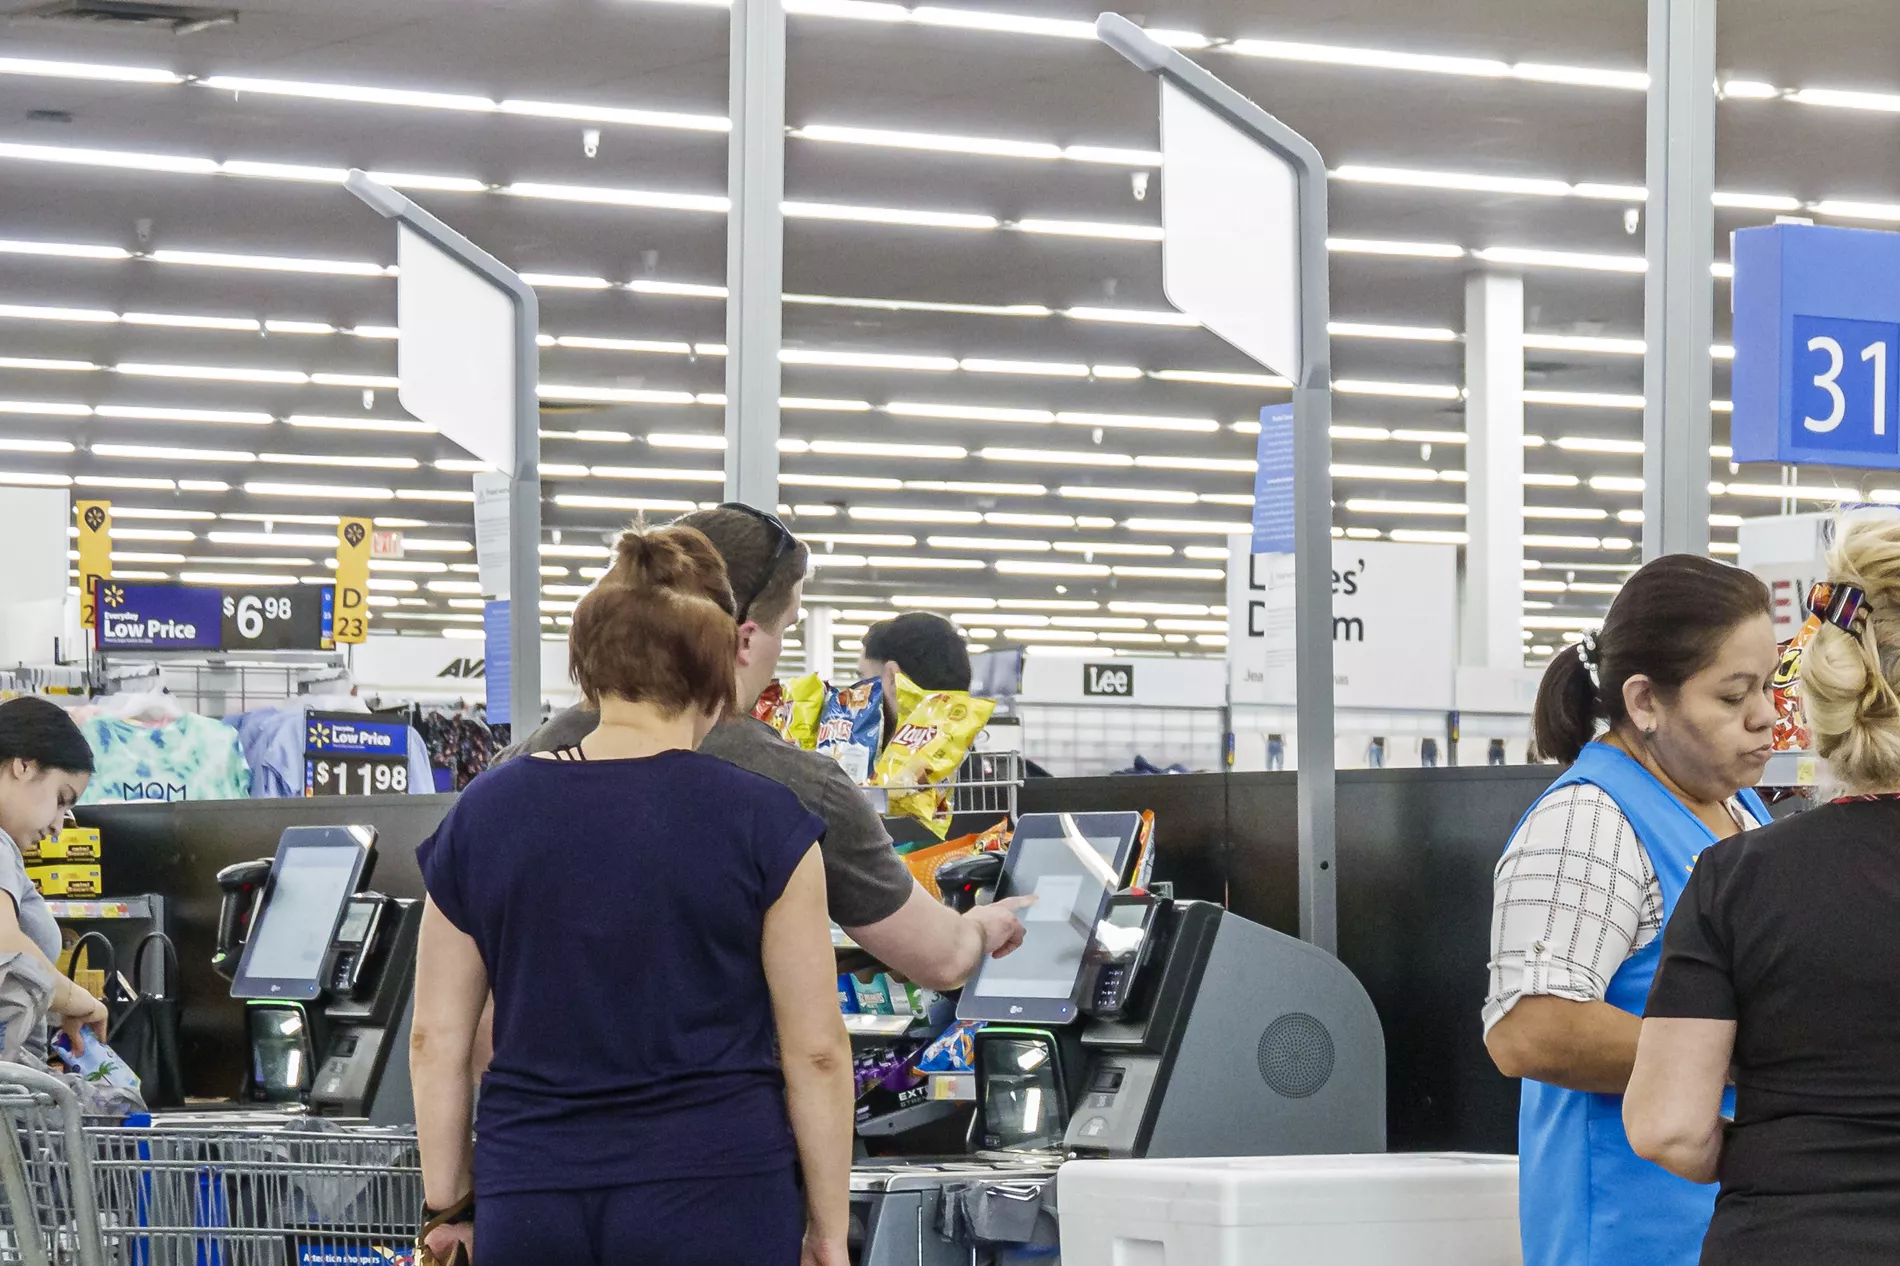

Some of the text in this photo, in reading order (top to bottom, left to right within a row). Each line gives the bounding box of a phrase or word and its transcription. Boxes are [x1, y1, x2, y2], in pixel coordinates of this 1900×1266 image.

[1803, 336, 1887, 436] 31
[343, 587, 361, 608] D
[104, 620, 196, 639] Low Price
[338, 616, 363, 638] 23
[1089, 667, 1128, 693] Lee
[332, 731, 359, 744] Low
[360, 731, 391, 747] Price
[892, 724, 938, 750] Lay's
[123, 782, 187, 801] MOM
